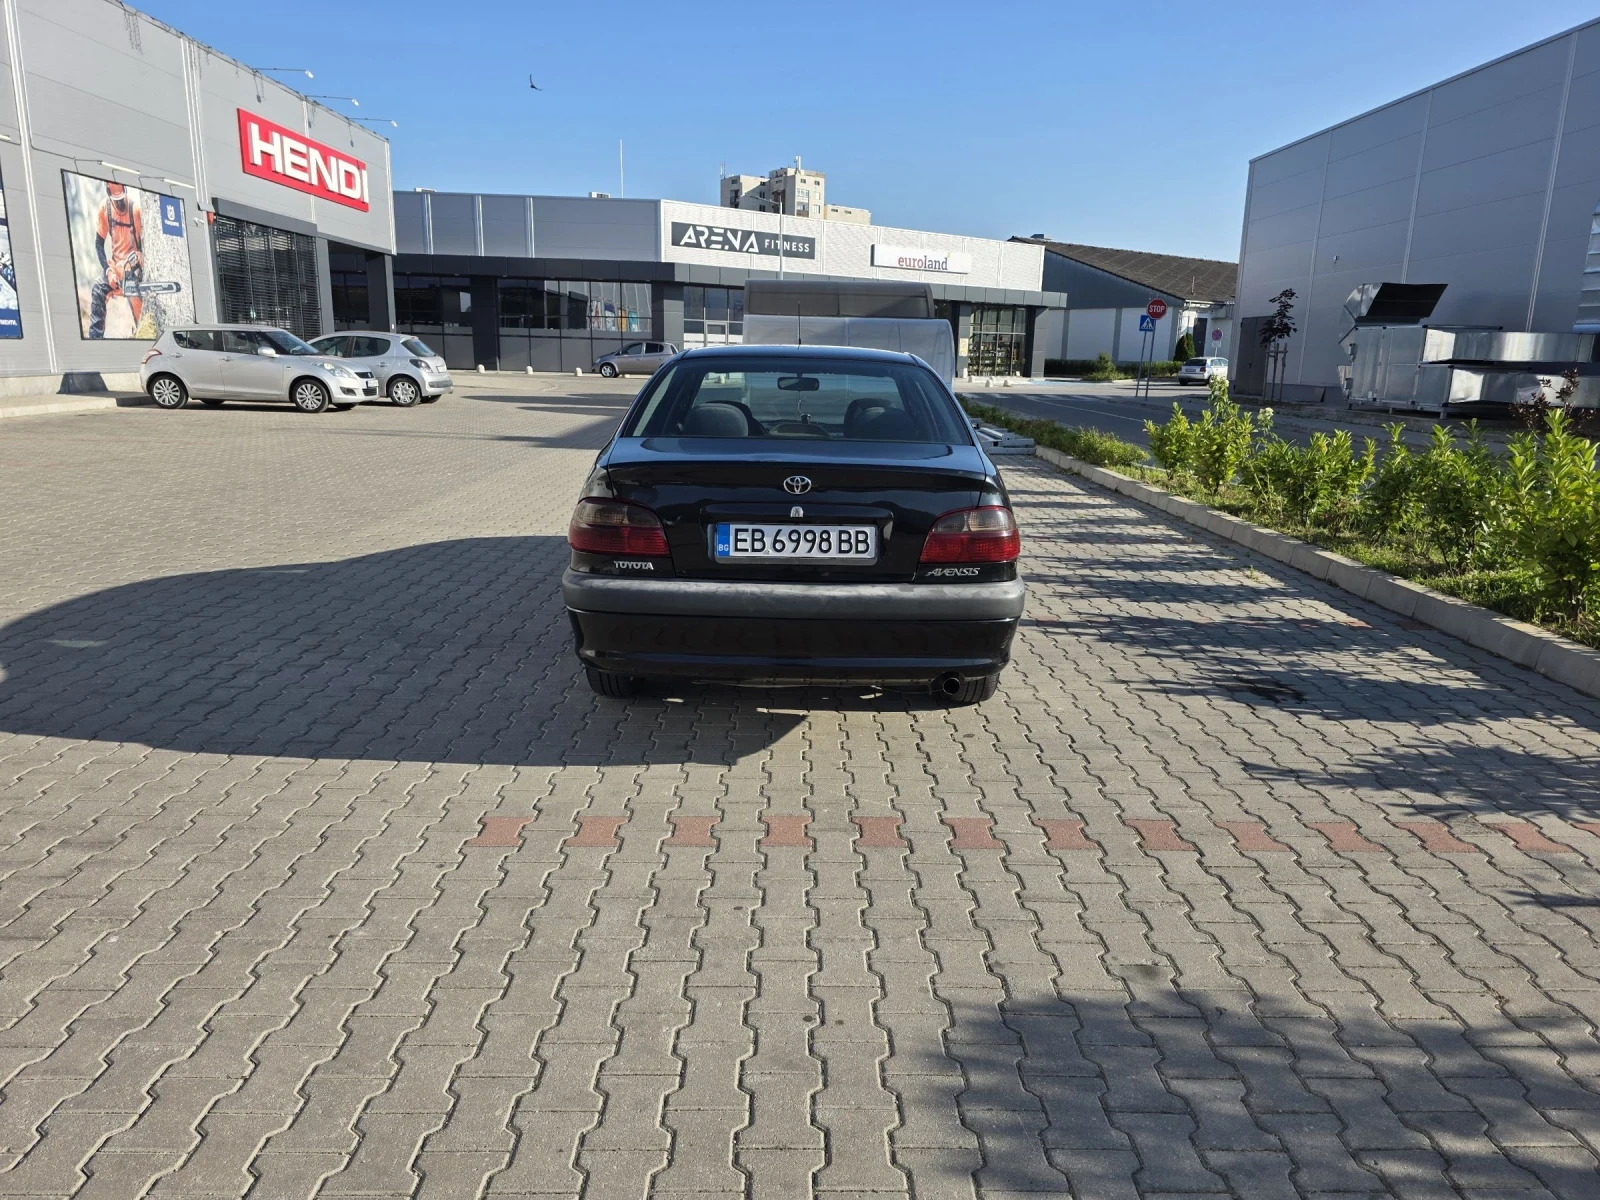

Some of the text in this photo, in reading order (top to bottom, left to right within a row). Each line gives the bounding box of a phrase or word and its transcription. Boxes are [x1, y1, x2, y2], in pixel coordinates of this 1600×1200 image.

[248, 122, 369, 203] HENDI
[680, 225, 810, 253] ARENA FITNESS
[897, 255, 948, 271] euroland
[1149, 305, 1165, 313] STOP
[718, 528, 870, 554] BG EB 6998 BB
[613, 560, 654, 570] TOYOTA
[925, 567, 981, 577] AVENSIS
